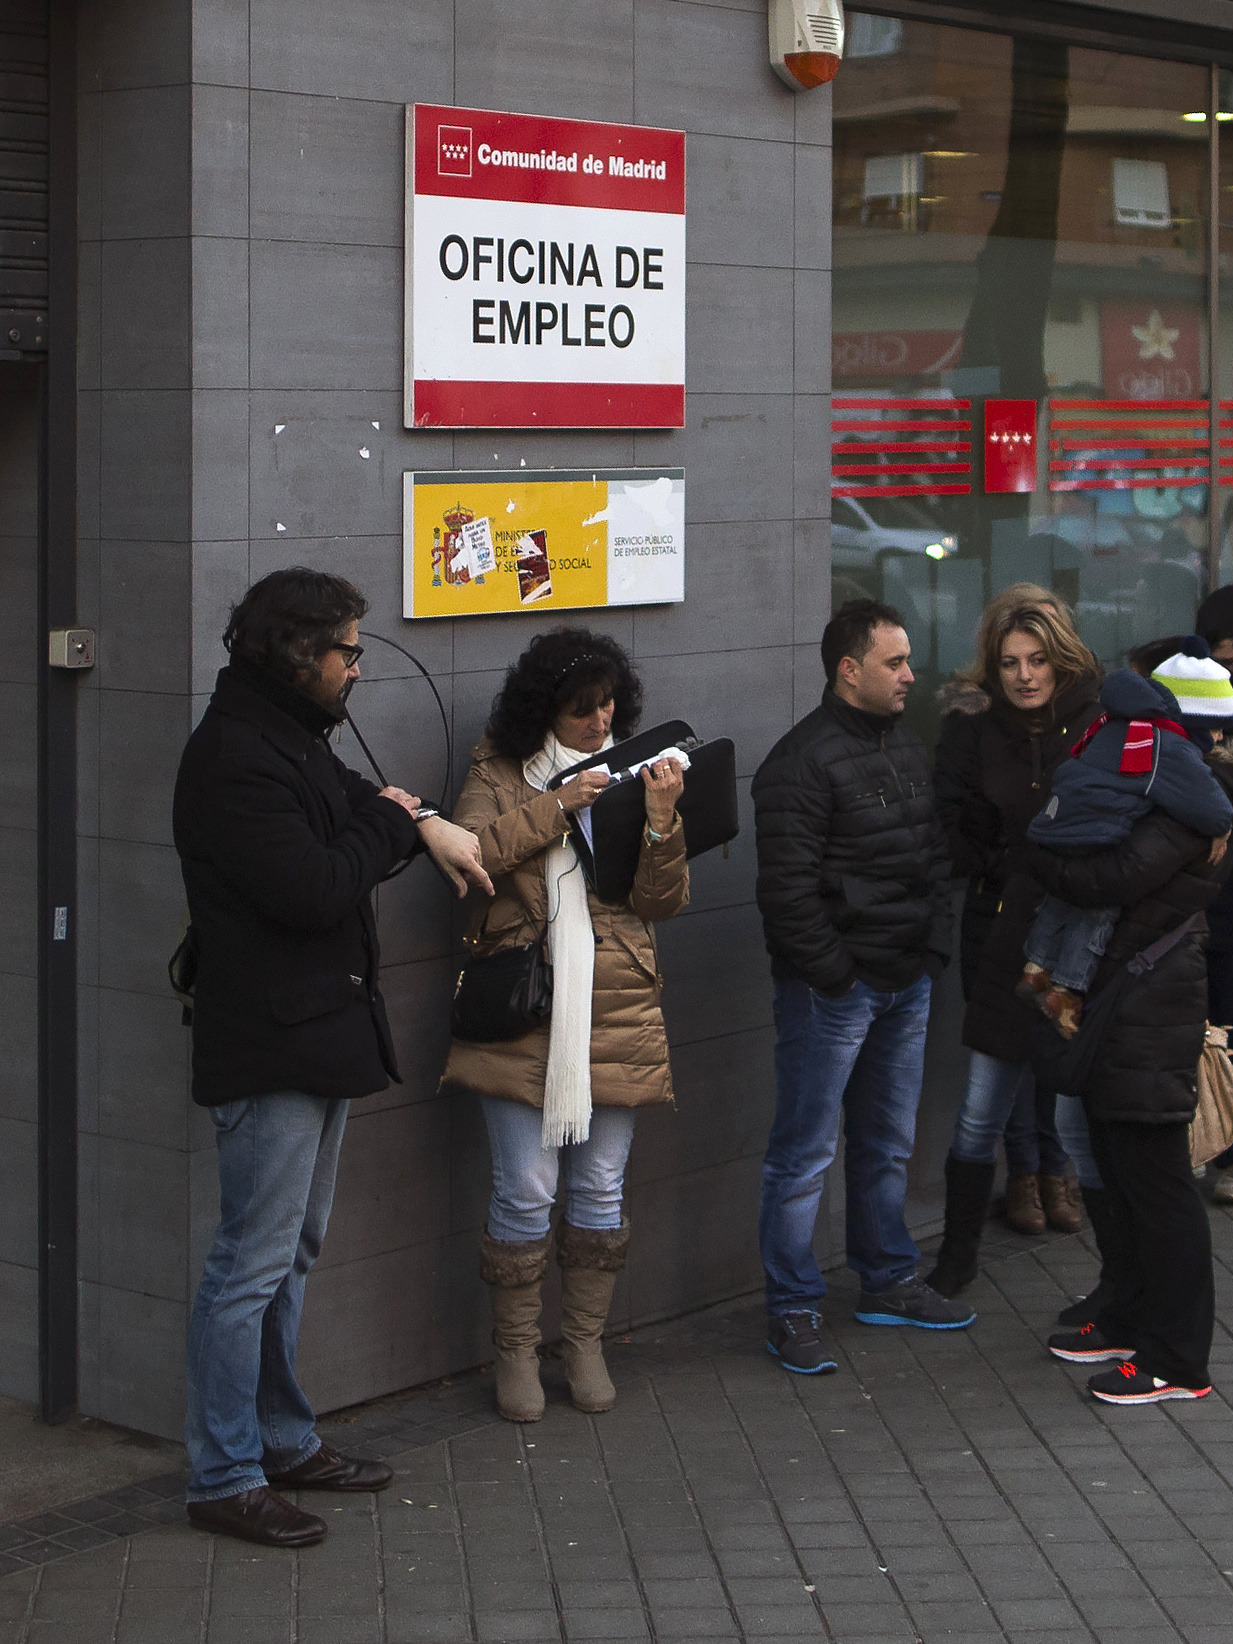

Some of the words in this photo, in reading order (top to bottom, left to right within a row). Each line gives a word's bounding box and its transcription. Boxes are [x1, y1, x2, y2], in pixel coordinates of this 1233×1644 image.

[477, 143, 578, 173] Comunidad
[582, 154, 604, 175] de
[608, 155, 667, 180] Madrid
[439, 234, 603, 288] OFICINA
[615, 245, 664, 291] DE
[472, 298, 635, 349] EMPLEO
[495, 529, 548, 541] MINIST
[614, 536, 644, 546] SERVICIO
[495, 546, 508, 557] DE
[614, 547, 624, 557] DE
[625, 547, 651, 557] EMPLEO
[652, 545, 677, 556] ESTATAL
[495, 561, 501, 572] Y
[559, 557, 592, 570] SOCIAL
